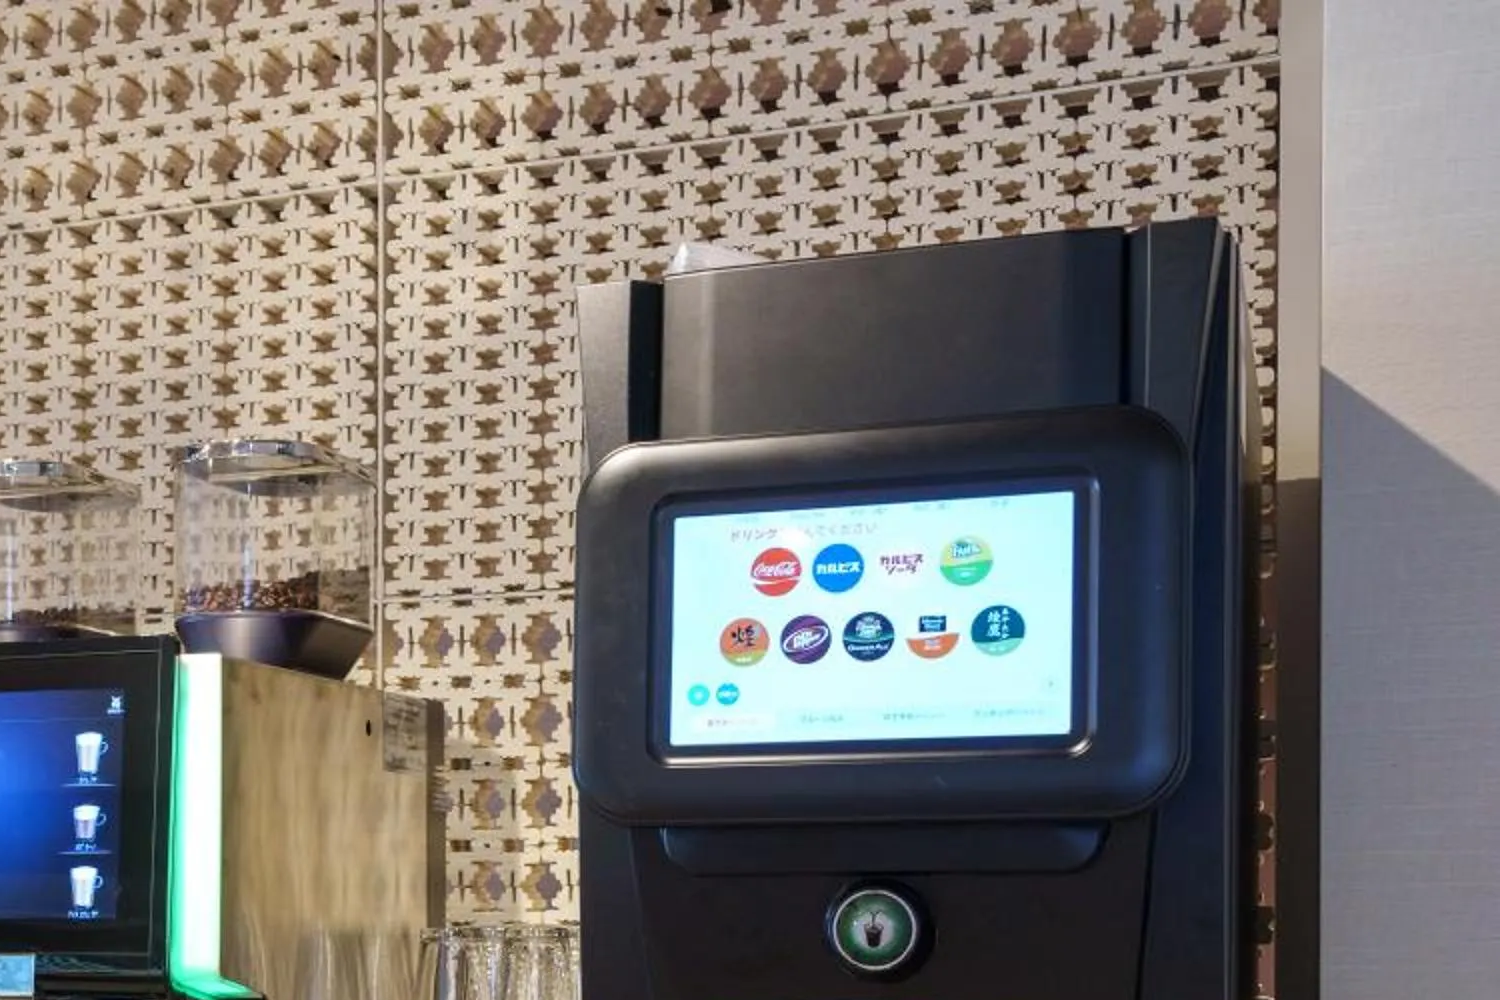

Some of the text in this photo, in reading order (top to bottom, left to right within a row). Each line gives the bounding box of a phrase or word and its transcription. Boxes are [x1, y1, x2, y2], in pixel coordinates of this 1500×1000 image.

[879, 553, 924, 566] カルピス
[816, 560, 861, 575] カルピス
